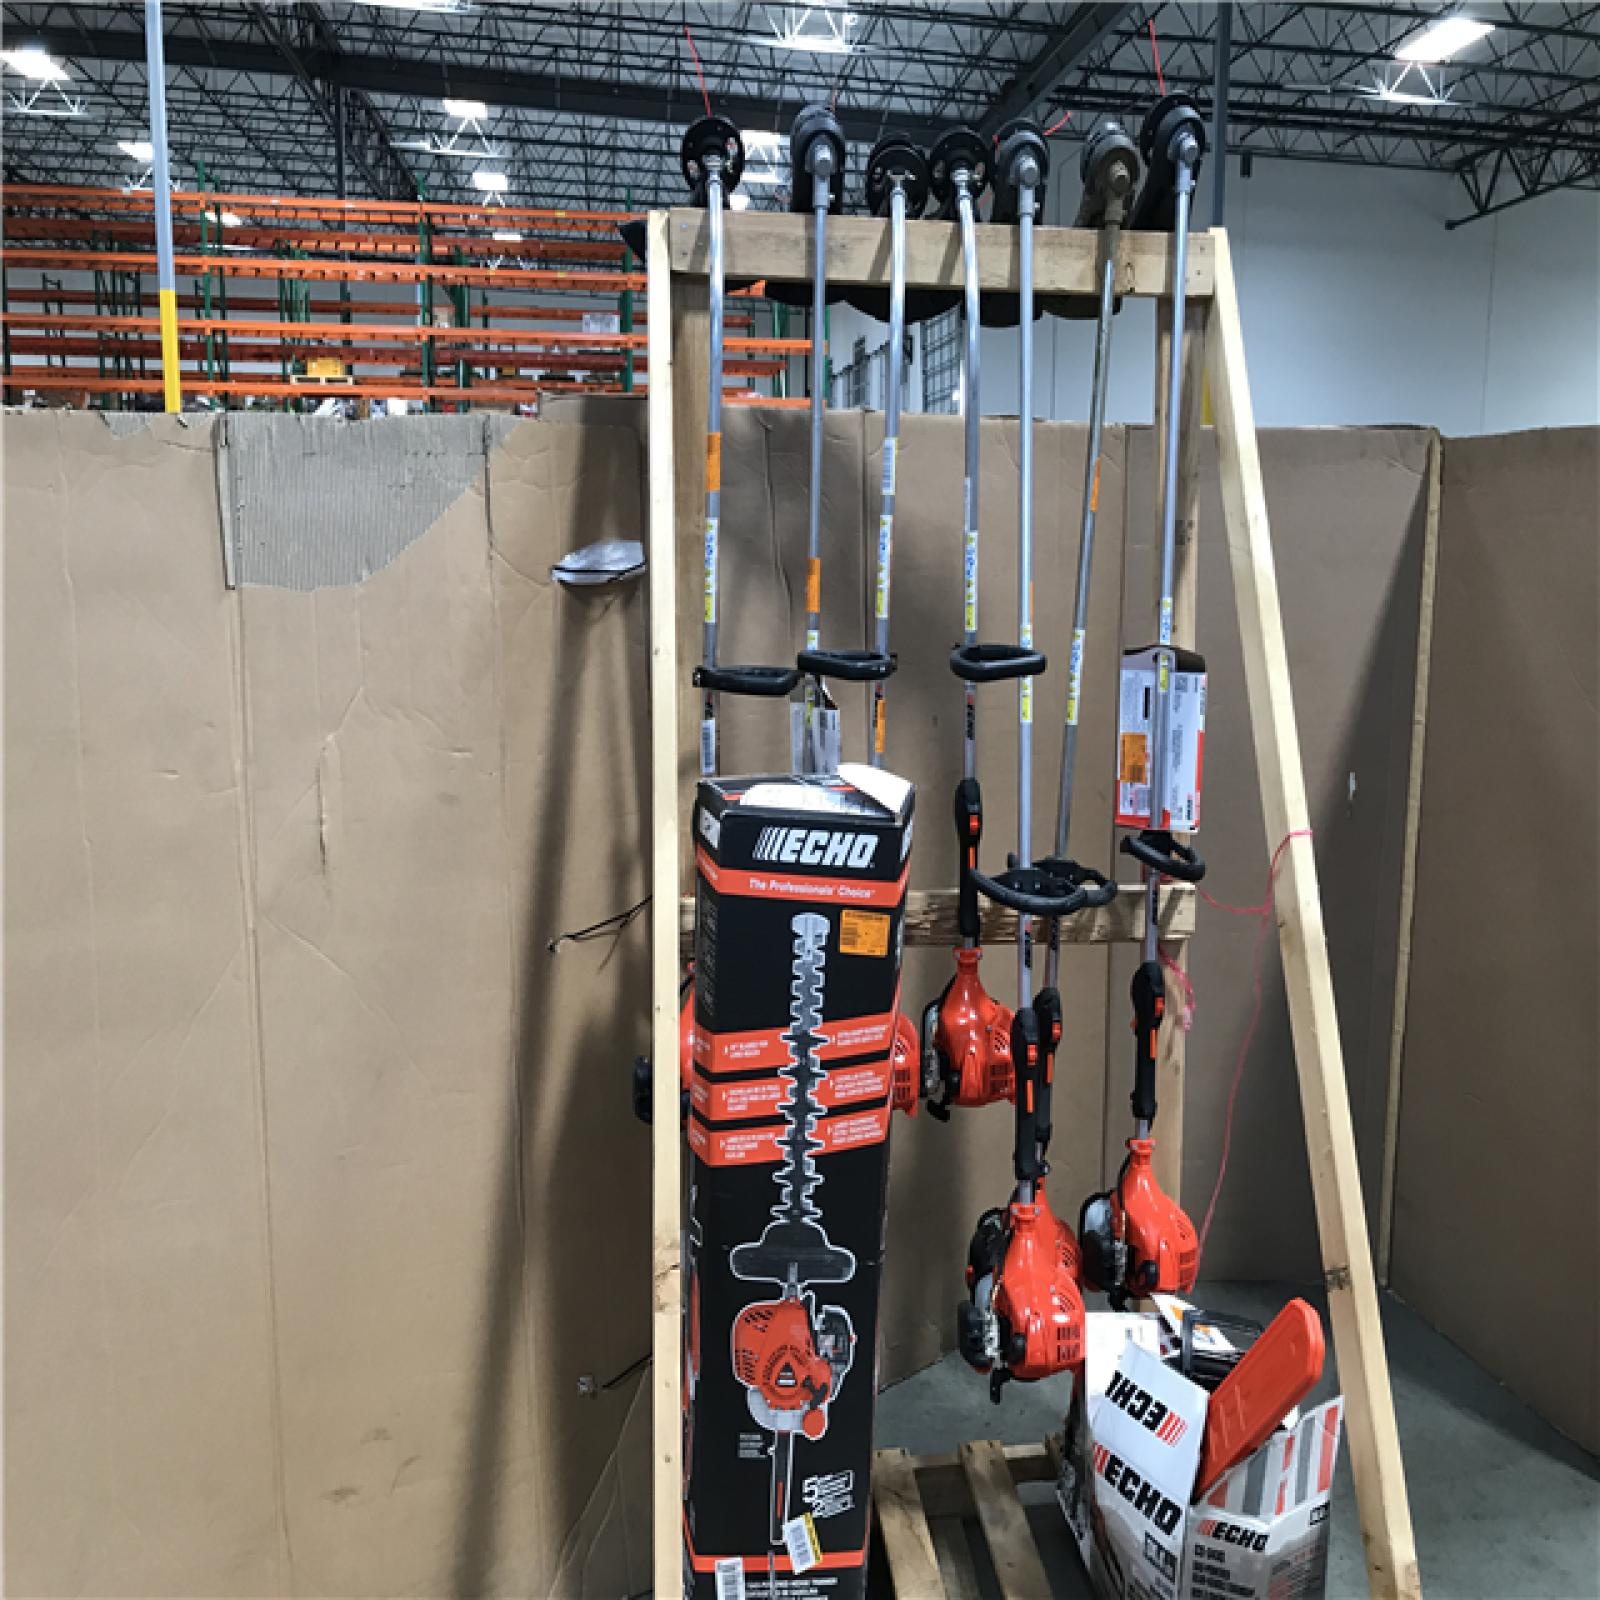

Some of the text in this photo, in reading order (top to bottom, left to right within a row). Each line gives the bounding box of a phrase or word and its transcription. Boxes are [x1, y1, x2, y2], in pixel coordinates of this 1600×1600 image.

[779, 828, 879, 869] ECHO
[749, 877, 765, 890] The
[1104, 1452, 1182, 1536] ECHO
[1212, 1522, 1270, 1552] ECHO
